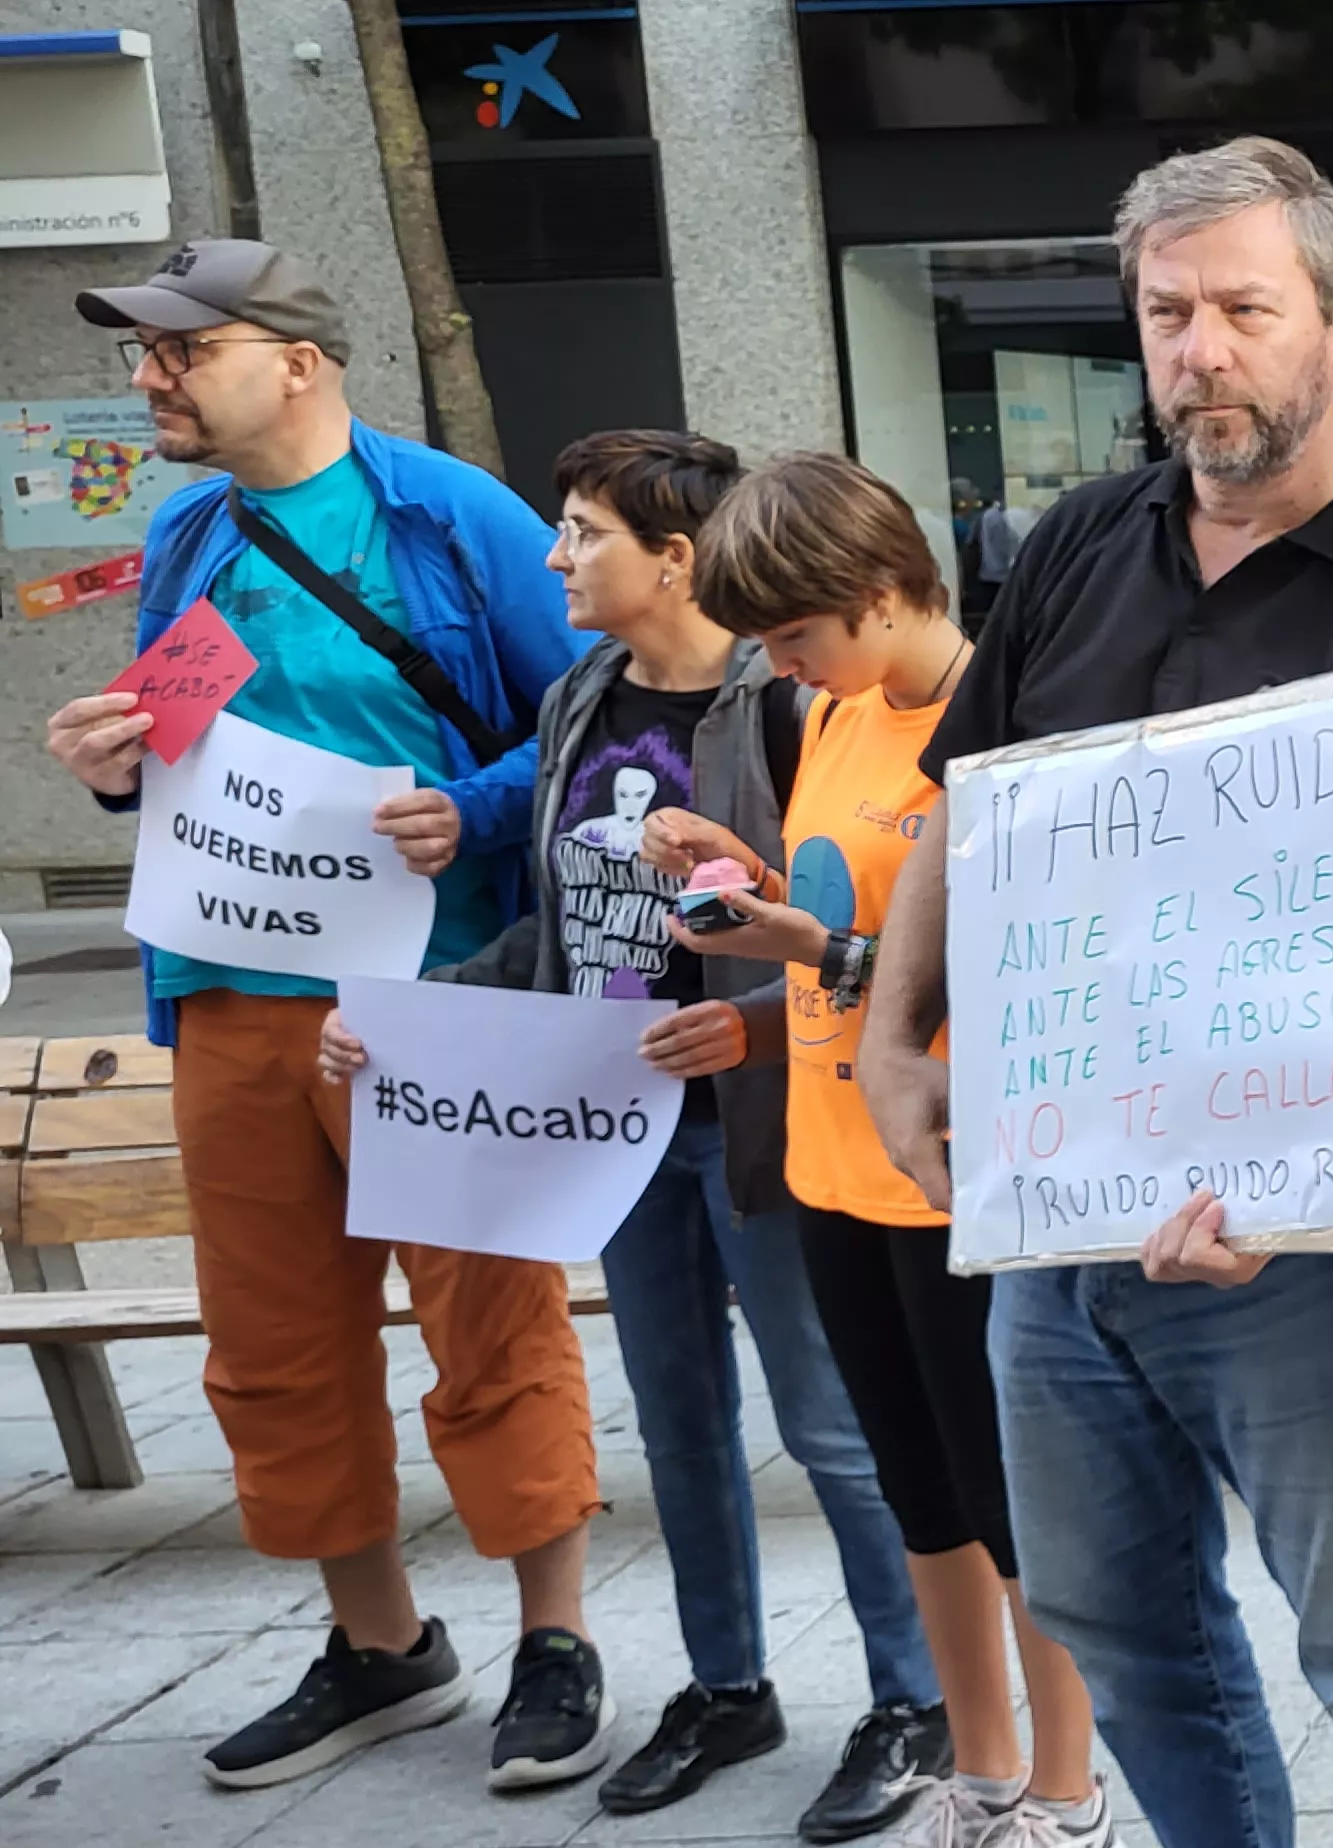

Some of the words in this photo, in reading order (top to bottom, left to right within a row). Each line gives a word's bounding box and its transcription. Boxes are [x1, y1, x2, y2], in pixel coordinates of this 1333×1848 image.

[223, 768, 284, 817] NOS
[1047, 767, 1186, 884] HAZ
[173, 812, 374, 882] QUEREMOS
[197, 891, 322, 936] VIVAS
[997, 914, 1108, 979] ANTE
[1152, 891, 1199, 943] EL
[1001, 981, 1101, 1048] ANTE
[1128, 958, 1188, 1008] LAS
[1004, 1045, 1099, 1100] ANTE
[1137, 1020, 1174, 1065] EL
[374, 1075, 649, 1145] #SeAcabó
[995, 1102, 1064, 1166] NO
[1111, 1082, 1168, 1139] TE
